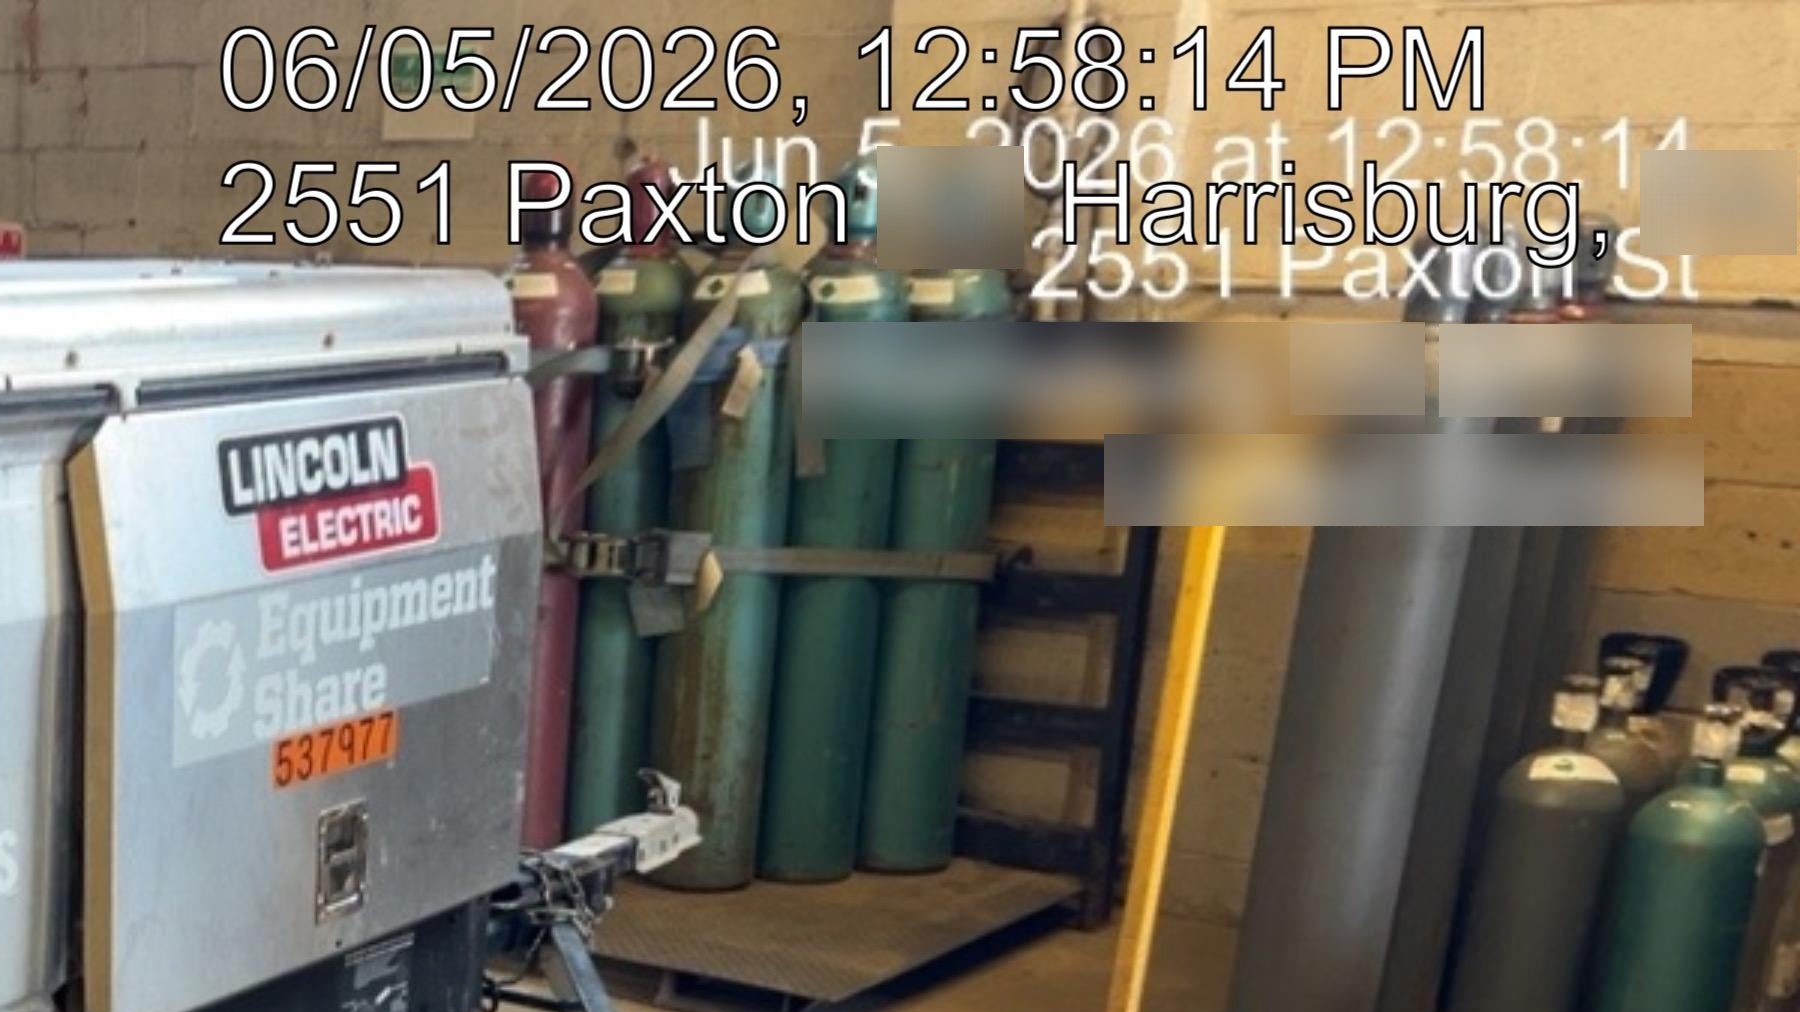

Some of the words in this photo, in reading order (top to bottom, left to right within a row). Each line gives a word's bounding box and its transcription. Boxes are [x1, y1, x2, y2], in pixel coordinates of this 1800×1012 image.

[226, 426, 400, 507] LINCOLN
[278, 493, 423, 560] ELECTRIC
[255, 553, 498, 667] Equipment
[251, 662, 389, 741] Share
[273, 711, 395, 788] 537977
